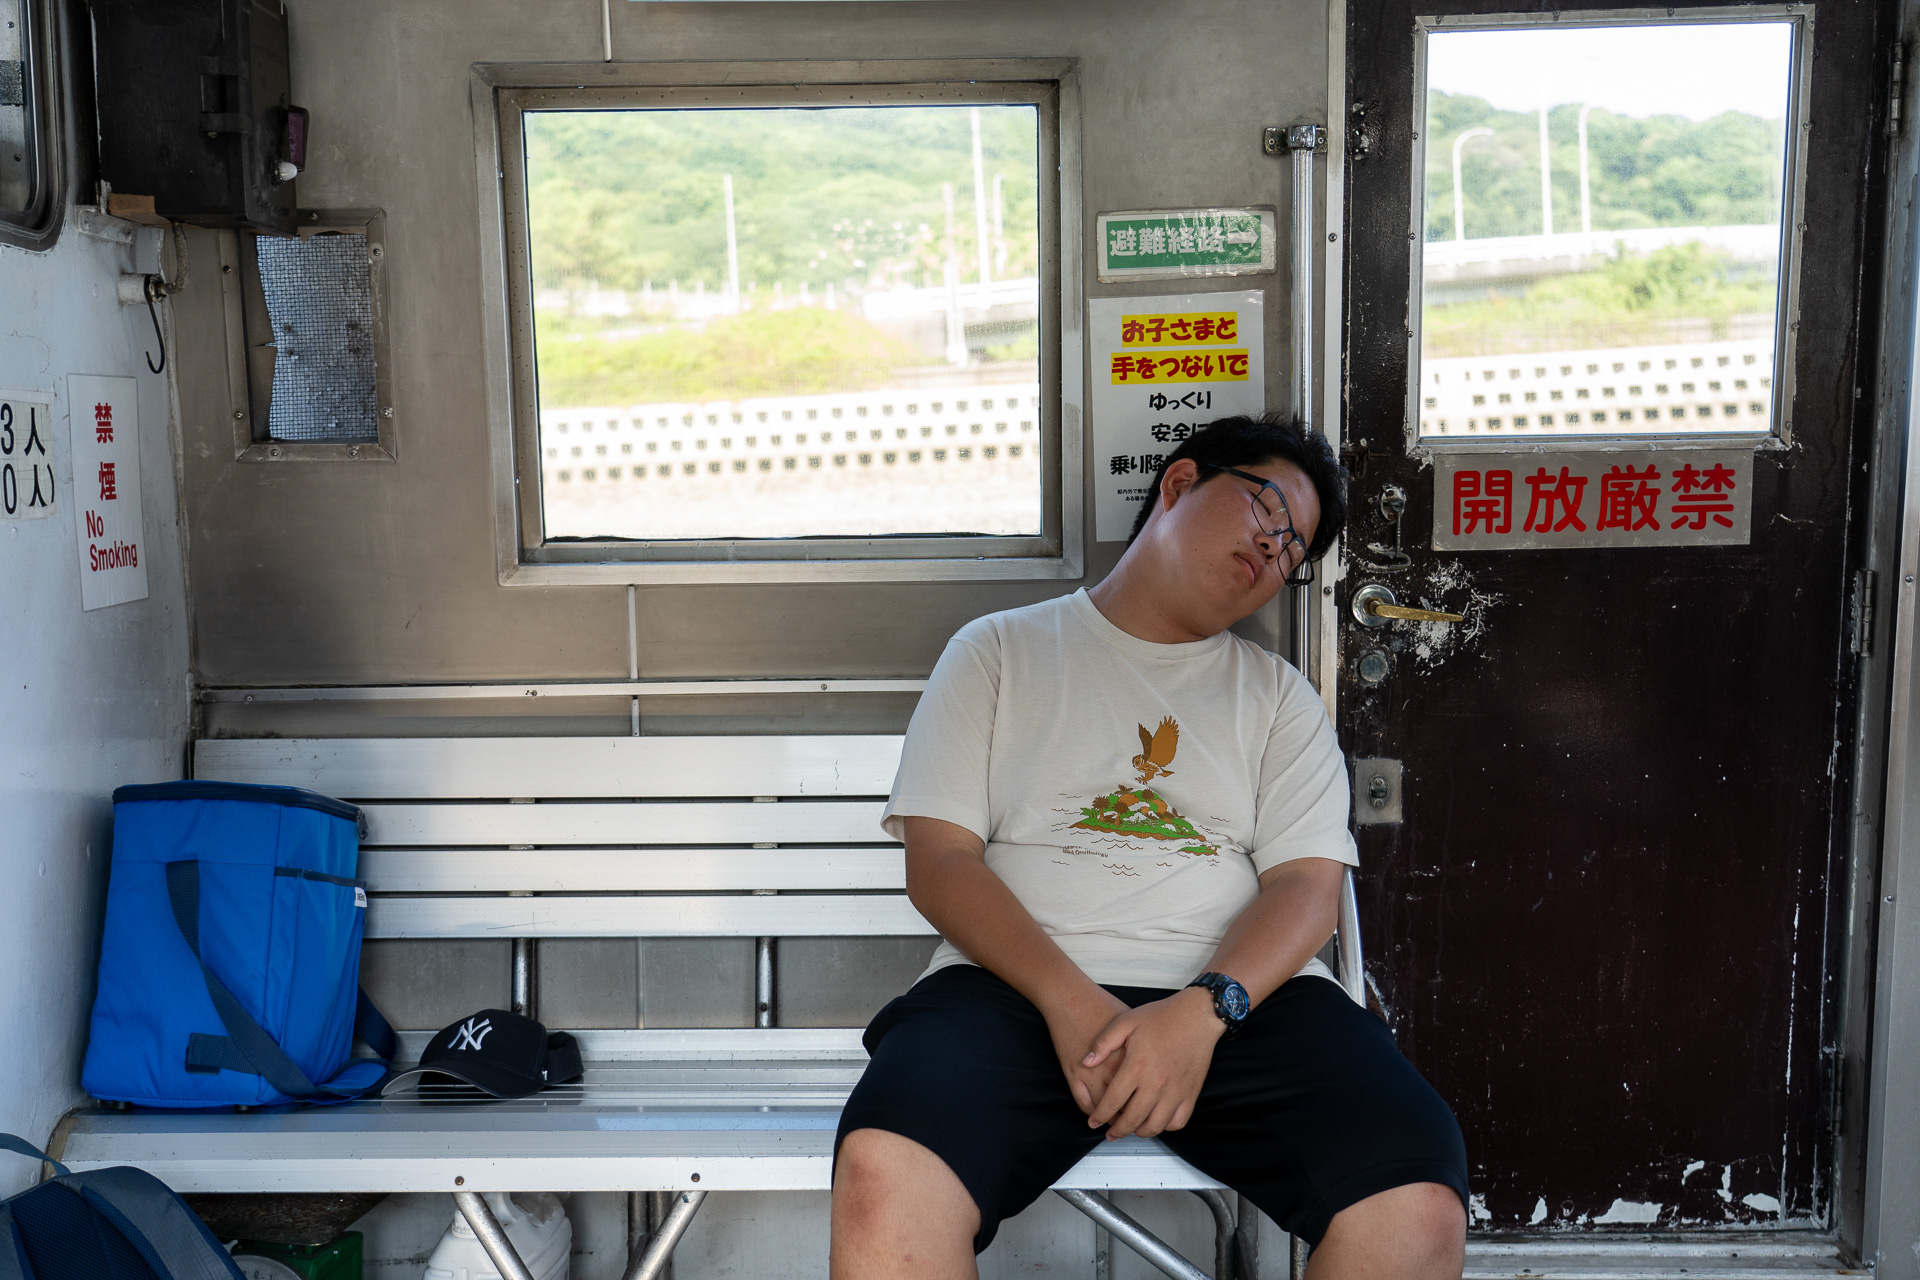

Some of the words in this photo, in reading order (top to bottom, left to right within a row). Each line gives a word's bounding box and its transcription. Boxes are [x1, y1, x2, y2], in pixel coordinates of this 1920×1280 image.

[1109, 226, 1225, 257] 避難経路
[1122, 317, 1237, 343] お子さまと
[1111, 354, 1248, 381] 手をつないで
[1149, 391, 1211, 411] ゆっくり
[95, 402, 118, 501] 禁煙
[1110, 454, 1169, 475] 乗り降
[1453, 463, 1736, 536] 開放厳禁
[86, 510, 104, 538] No
[90, 540, 138, 572] Smoking
[448, 1017, 493, 1051] NY
